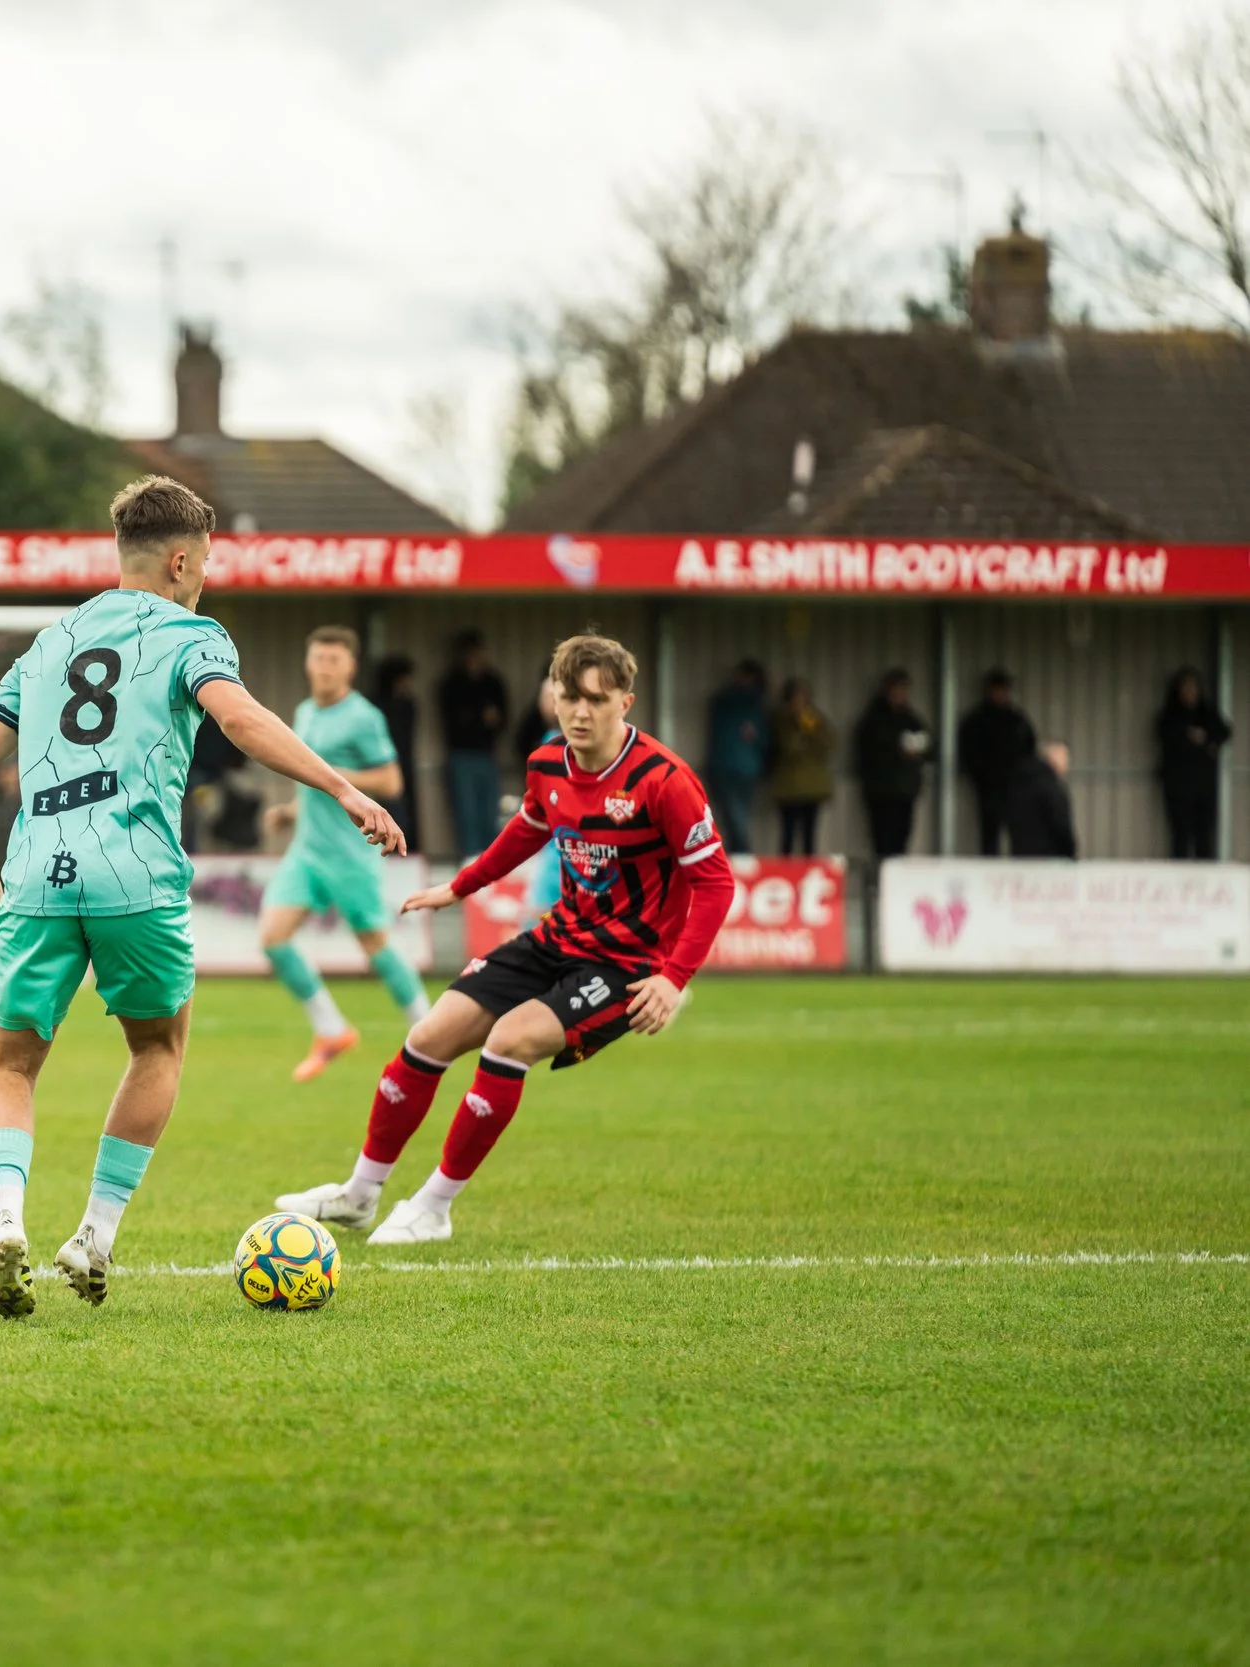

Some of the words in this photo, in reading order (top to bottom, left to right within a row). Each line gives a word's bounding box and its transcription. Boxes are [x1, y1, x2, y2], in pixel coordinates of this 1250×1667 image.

[392, 538, 463, 585] Ltd
[674, 540, 869, 588] A.E.SMITH
[871, 543, 1101, 591] BODYCRAFT
[1104, 546, 1168, 593] Ltd
[59, 647, 122, 745] 8
[39, 775, 111, 812] IREN
[579, 976, 611, 1007] 20
[247, 1278, 270, 1294] DELTA
[294, 1273, 318, 1301] KTFC
